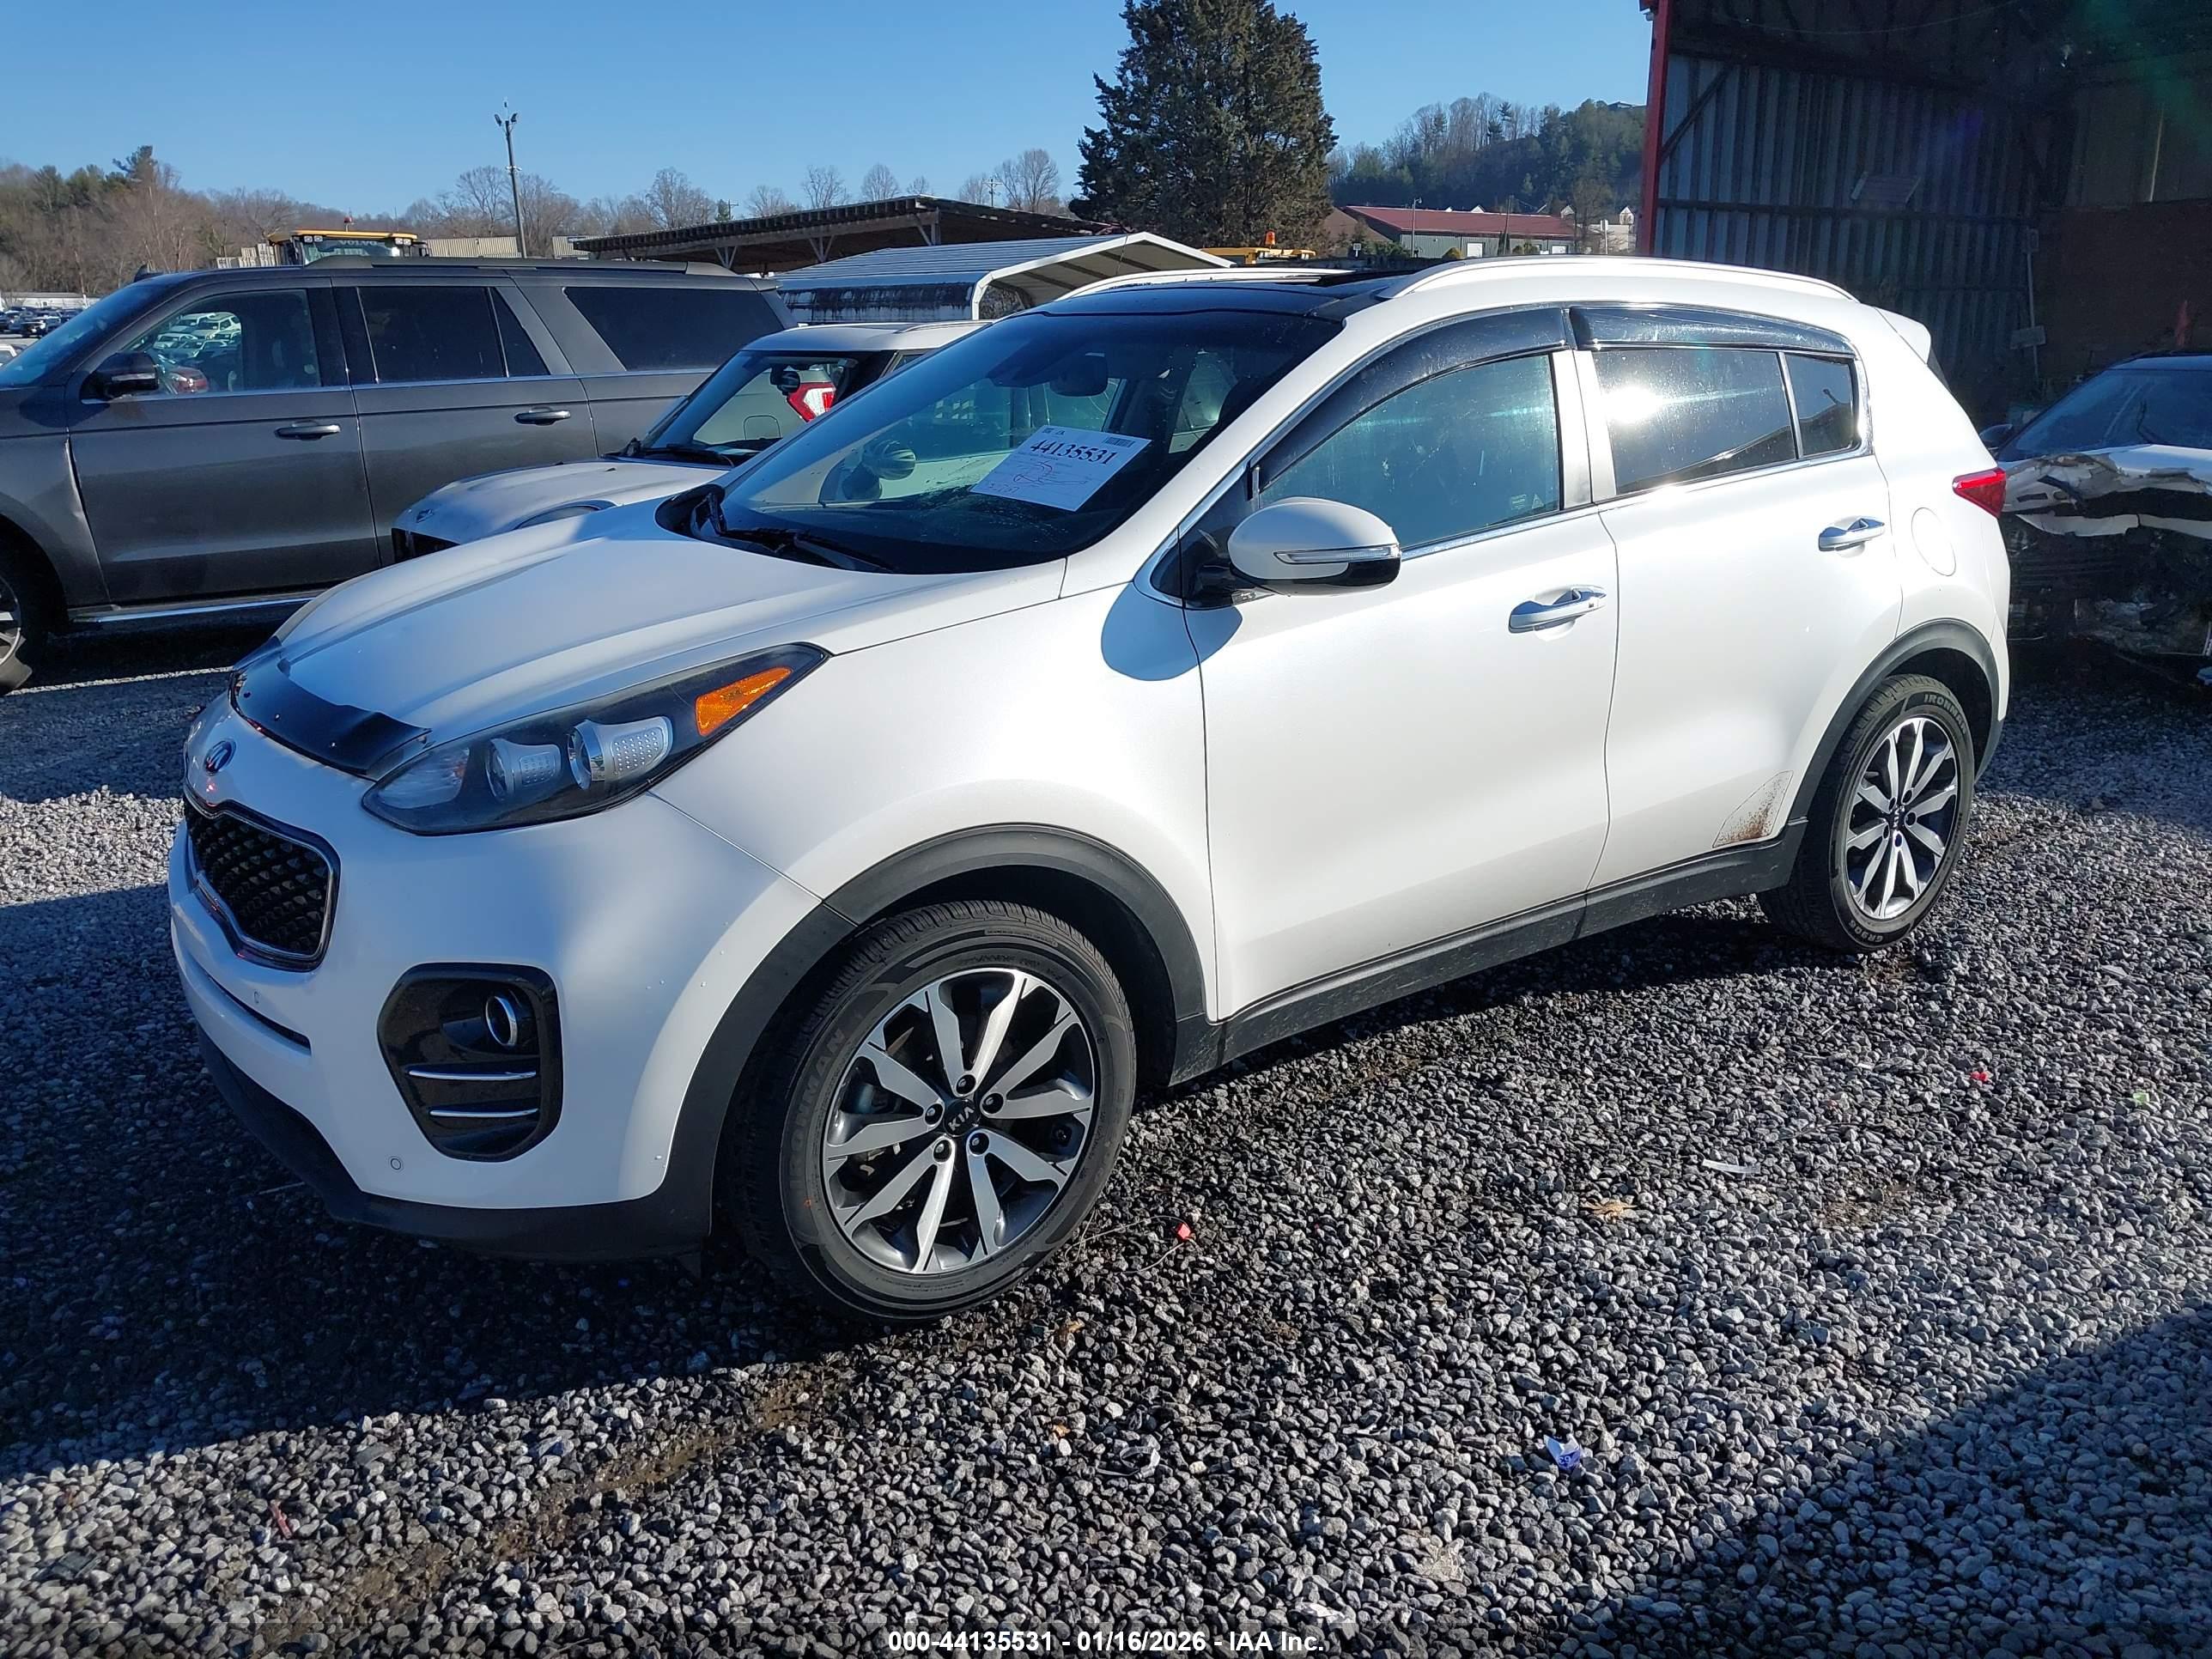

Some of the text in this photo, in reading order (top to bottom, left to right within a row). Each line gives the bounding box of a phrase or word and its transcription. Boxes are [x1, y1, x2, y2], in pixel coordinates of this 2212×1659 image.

[1030, 439, 1118, 465] 44135531
[1924, 694, 1966, 735] IRONMAN
[789, 1029, 846, 1189] IRONMAN
[948, 1106, 975, 1131] KIA
